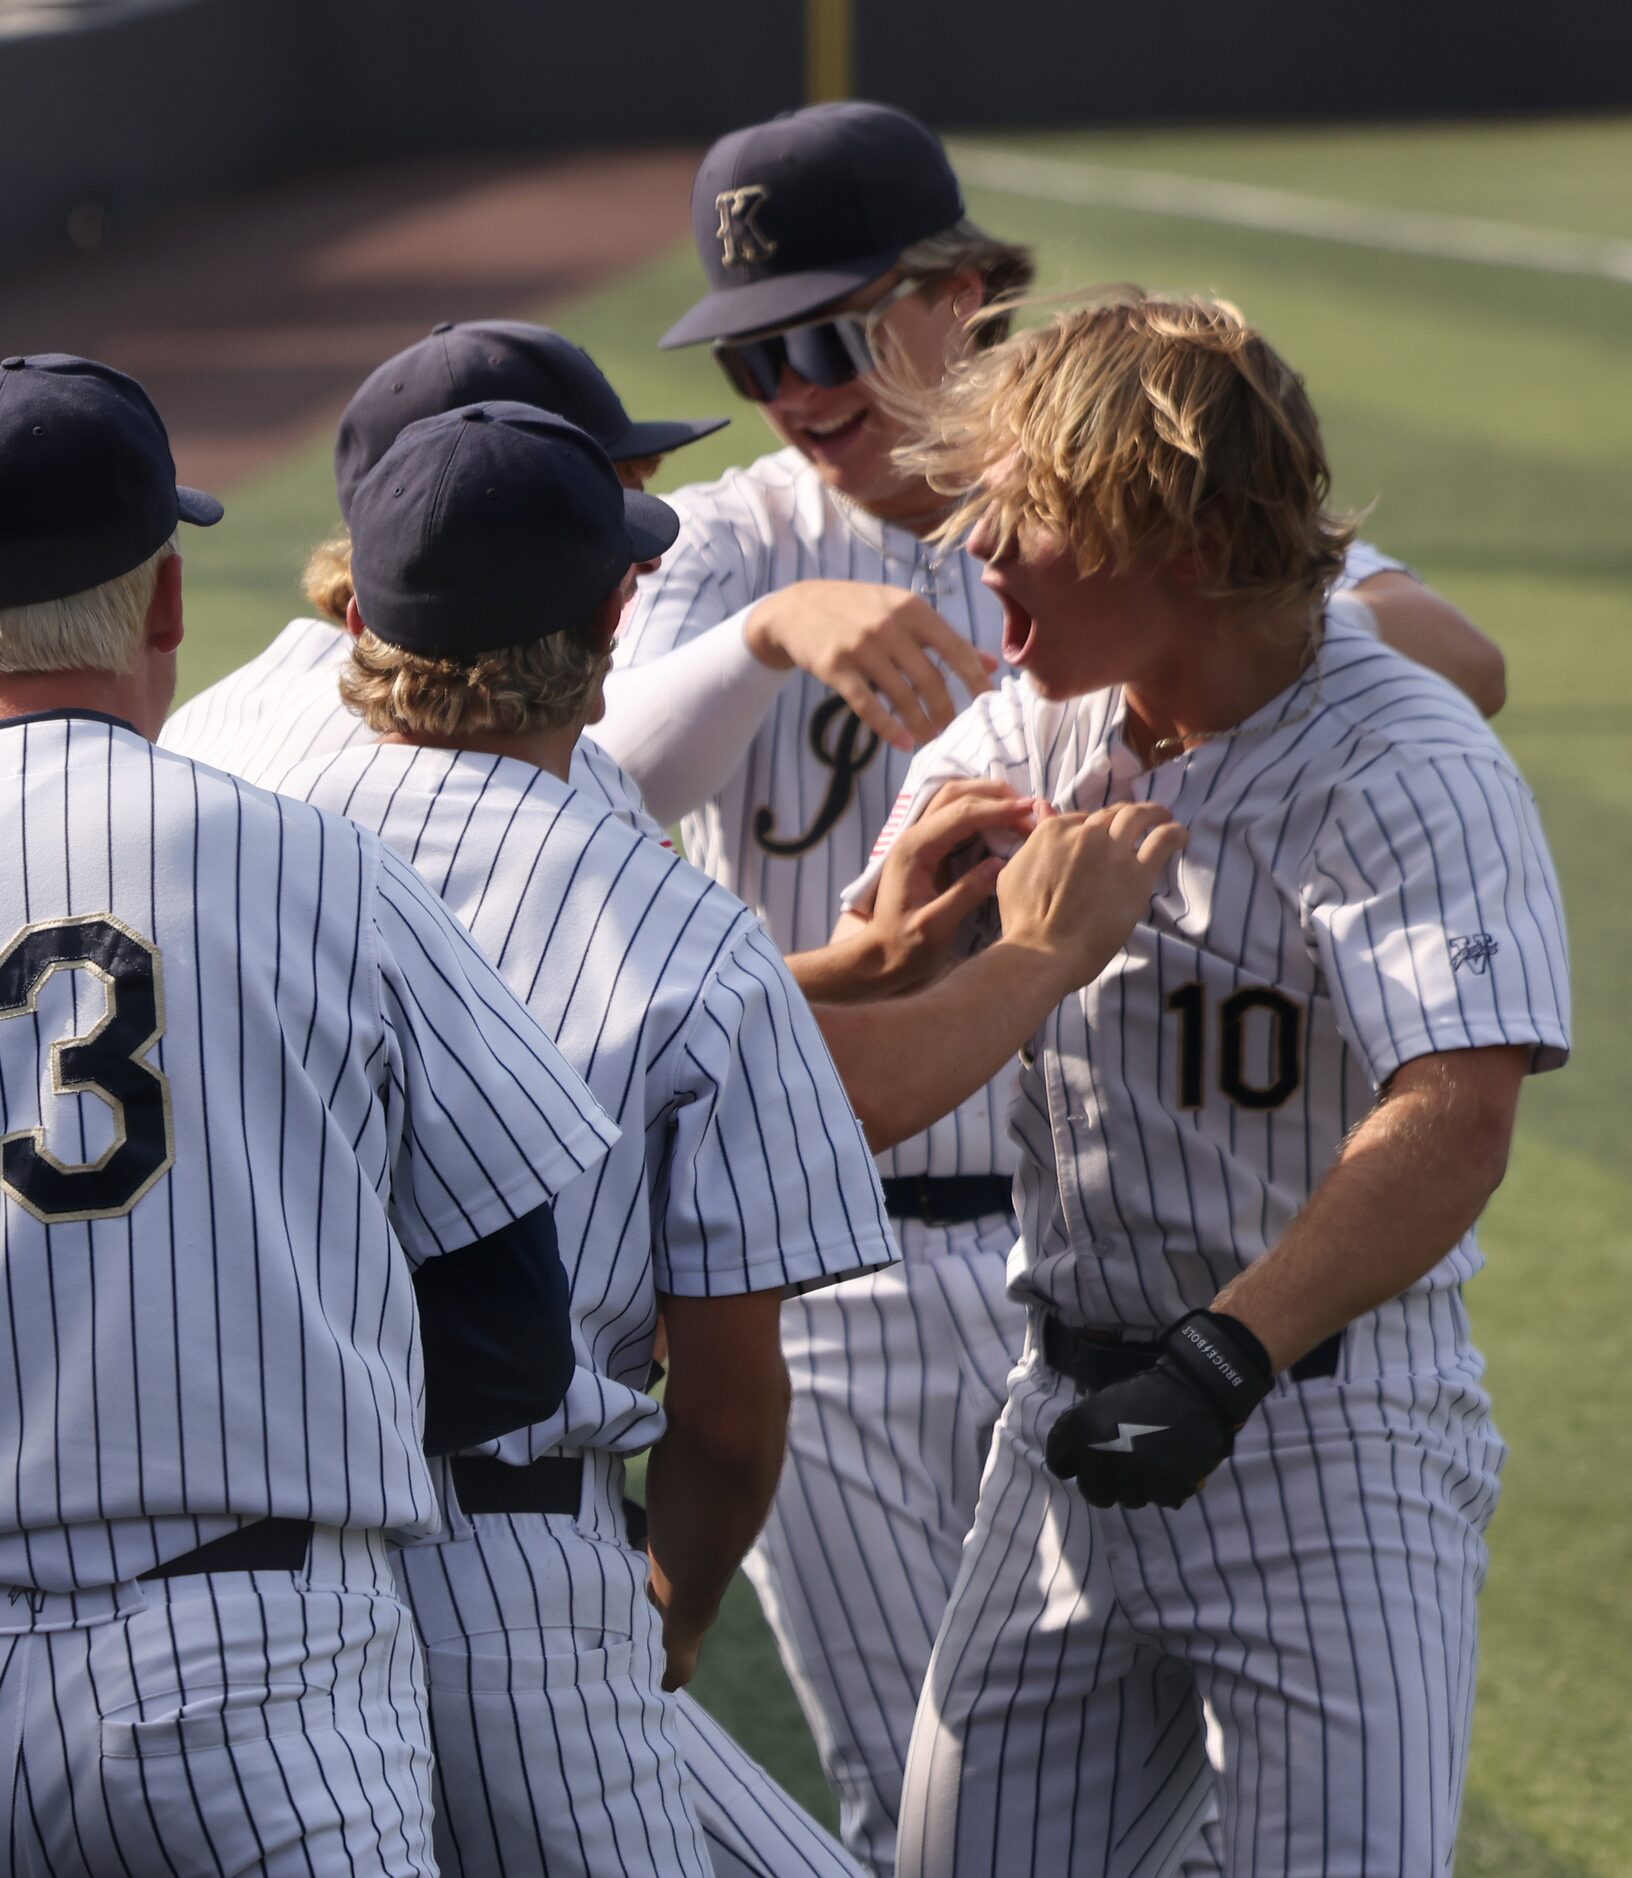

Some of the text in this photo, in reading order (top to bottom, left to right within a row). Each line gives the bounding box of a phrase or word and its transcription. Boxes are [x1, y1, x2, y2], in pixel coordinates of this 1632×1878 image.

[715, 184, 777, 267] K
[1165, 980, 1305, 1112] 10
[1181, 1325, 1243, 1388] BRUCE BOLT
